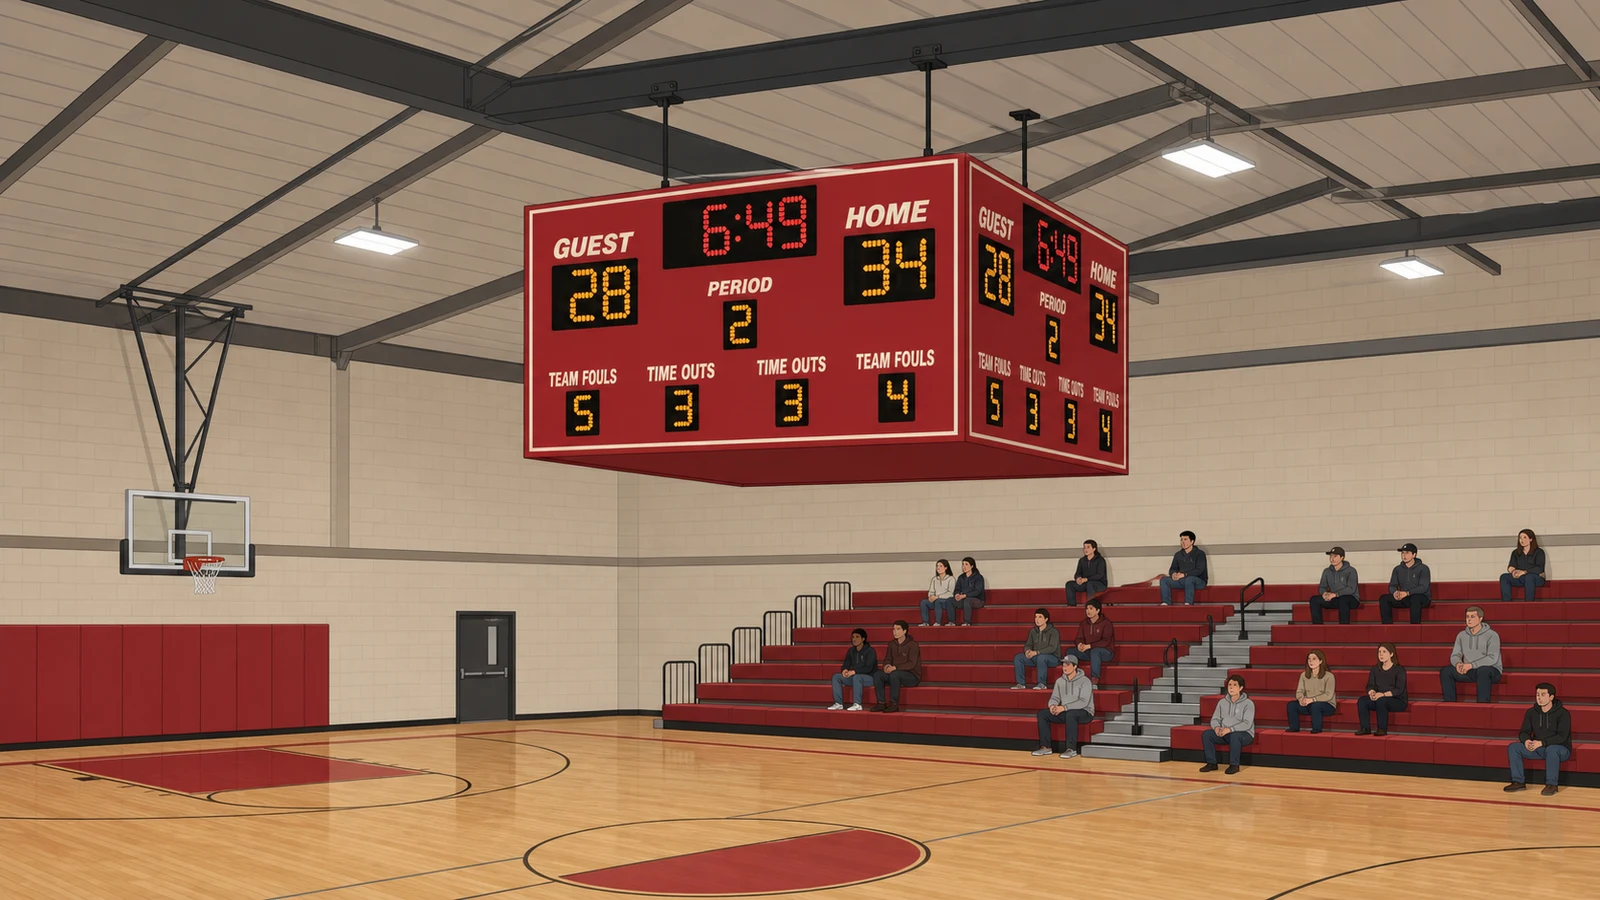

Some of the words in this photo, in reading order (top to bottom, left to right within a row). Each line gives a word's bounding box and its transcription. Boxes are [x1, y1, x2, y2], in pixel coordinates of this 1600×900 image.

[703, 195, 807, 257] 6:49
[845, 200, 930, 229] HOME
[979, 207, 1014, 240] GUEST
[554, 231, 634, 259] GUEST
[1037, 219, 1078, 284] 6:49
[862, 238, 927, 296] 34
[985, 244, 1011, 306] 28
[1090, 261, 1117, 289] HOME
[570, 265, 630, 322] 28
[708, 277, 772, 296] PERIOD
[1040, 292, 1066, 314] PERIOD
[730, 305, 751, 344] 2
[1095, 293, 1115, 344] 34
[1049, 321, 1058, 359] 2
[647, 365, 677, 382] TIME
[681, 363, 715, 380] OUTS
[757, 358, 787, 375] TIME
[793, 356, 826, 373] OUTS
[856, 352, 890, 370] TEAM
[895, 349, 934, 367] FOULS
[978, 352, 993, 371] TEAM
[994, 357, 1011, 376] FOULS
[1020, 365, 1031, 383] TIME
[1033, 369, 1045, 387] OUTS
[549, 371, 578, 387] TEAM
[582, 369, 617, 385] FOULS
[1059, 376, 1070, 394] TIME
[1071, 380, 1084, 397] OUTS
[574, 395, 593, 431] 5
[674, 390, 693, 427] 3
[783, 384, 802, 422] 3
[887, 379, 908, 414] 4
[991, 383, 1000, 421] 5
[1029, 393, 1038, 430] 3
[1093, 387, 1105, 404] TEAM
[1106, 391, 1119, 408] FOULS
[1068, 404, 1075, 439] 3
[1102, 415, 1110, 446] 4
